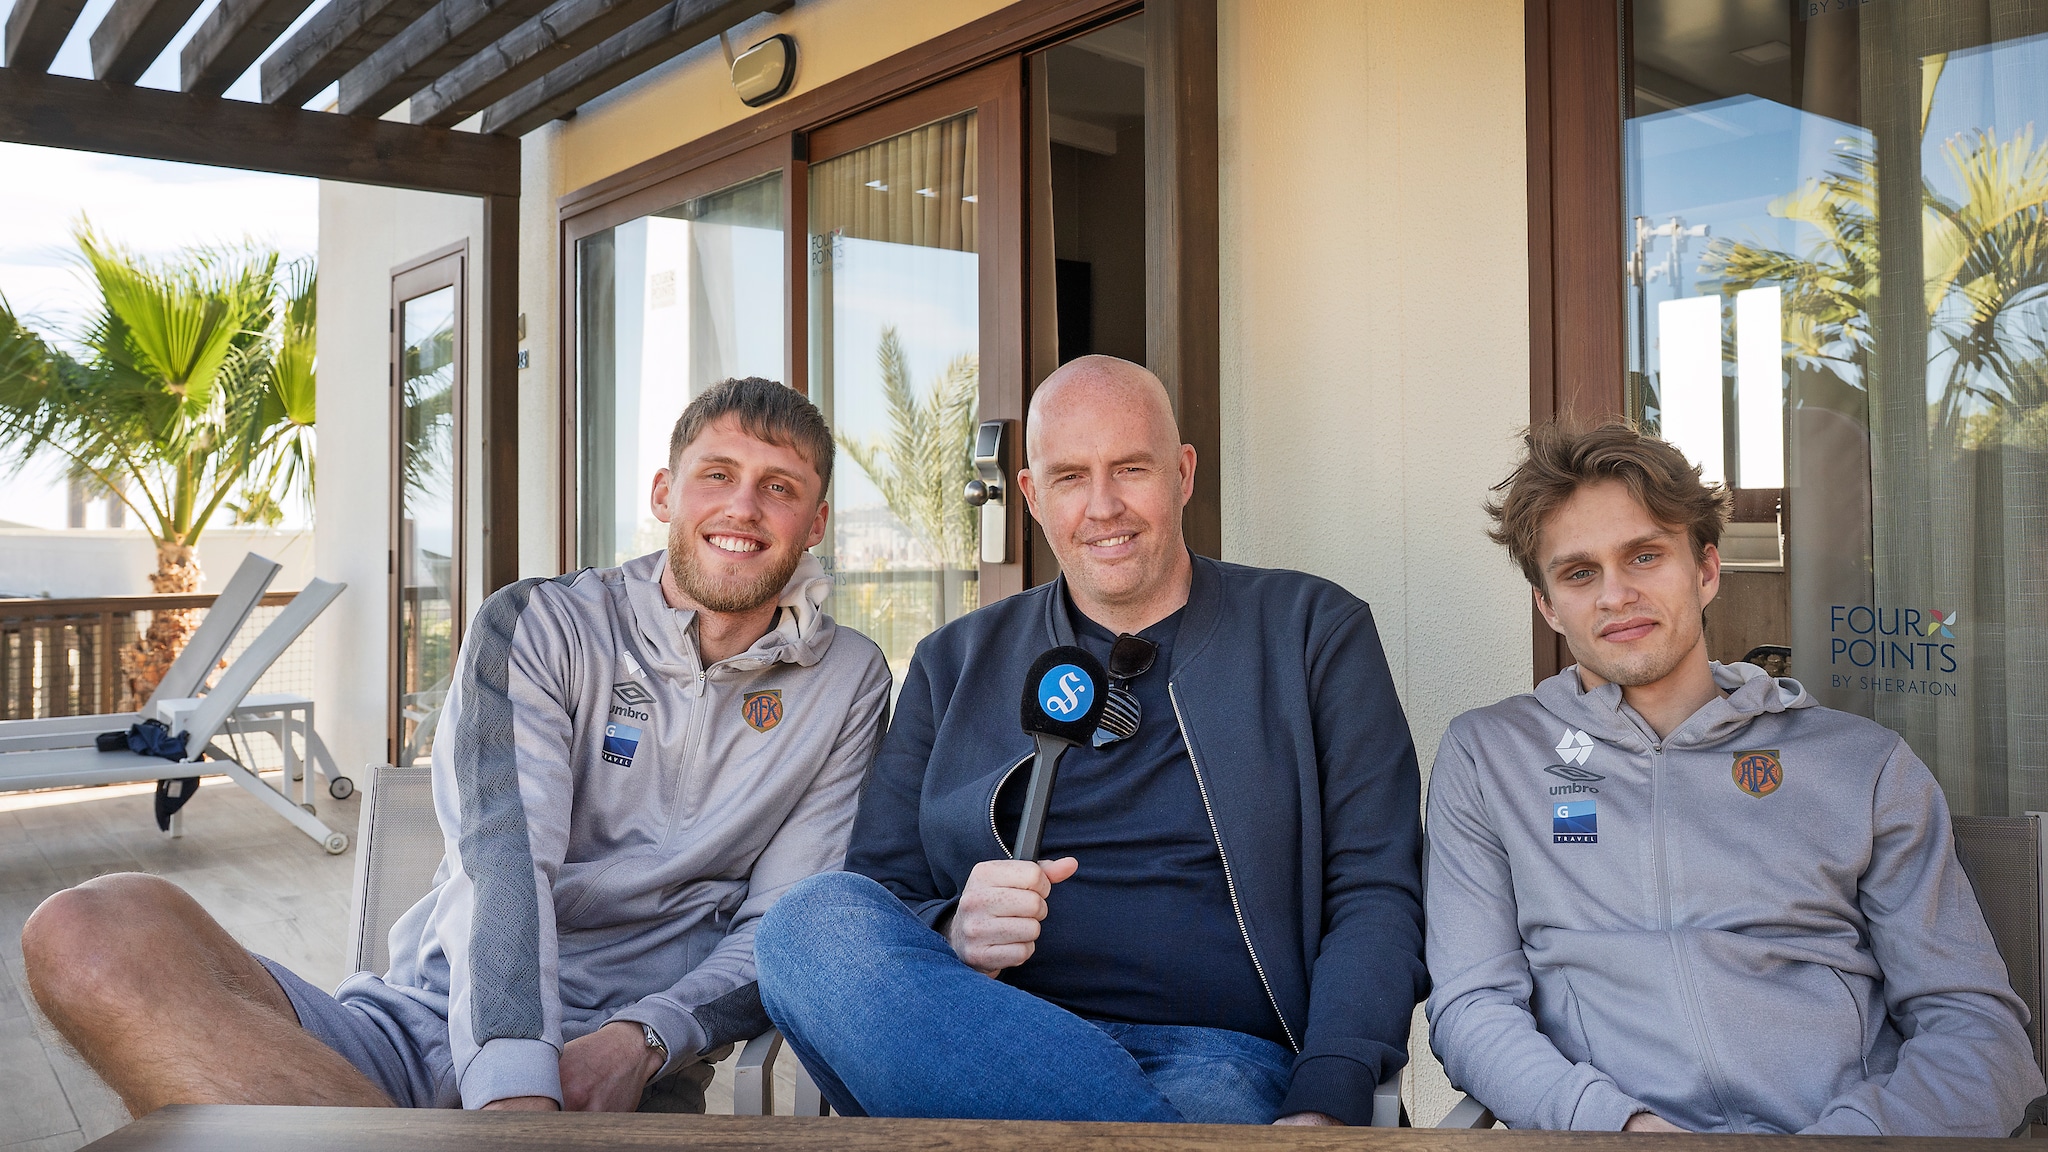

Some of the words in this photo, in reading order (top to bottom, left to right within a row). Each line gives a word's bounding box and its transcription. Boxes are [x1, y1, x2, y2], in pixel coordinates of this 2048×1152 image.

[1810, 0, 1829, 17] BY
[812, 231, 835, 250] FOUR
[812, 244, 843, 265] POINTS
[816, 556, 839, 570] OUR
[1831, 605, 1925, 637] FOUR
[1831, 638, 1957, 673] POINTS
[1832, 674, 1852, 689] BY
[1860, 676, 1957, 697] SHERATON
[747, 696, 779, 728] AFK
[605, 724, 617, 737] G
[1738, 756, 1779, 793] AFK
[1549, 782, 1600, 796] umbro
[1556, 805, 1569, 819] G
[1556, 835, 1595, 843] TRAVEL
